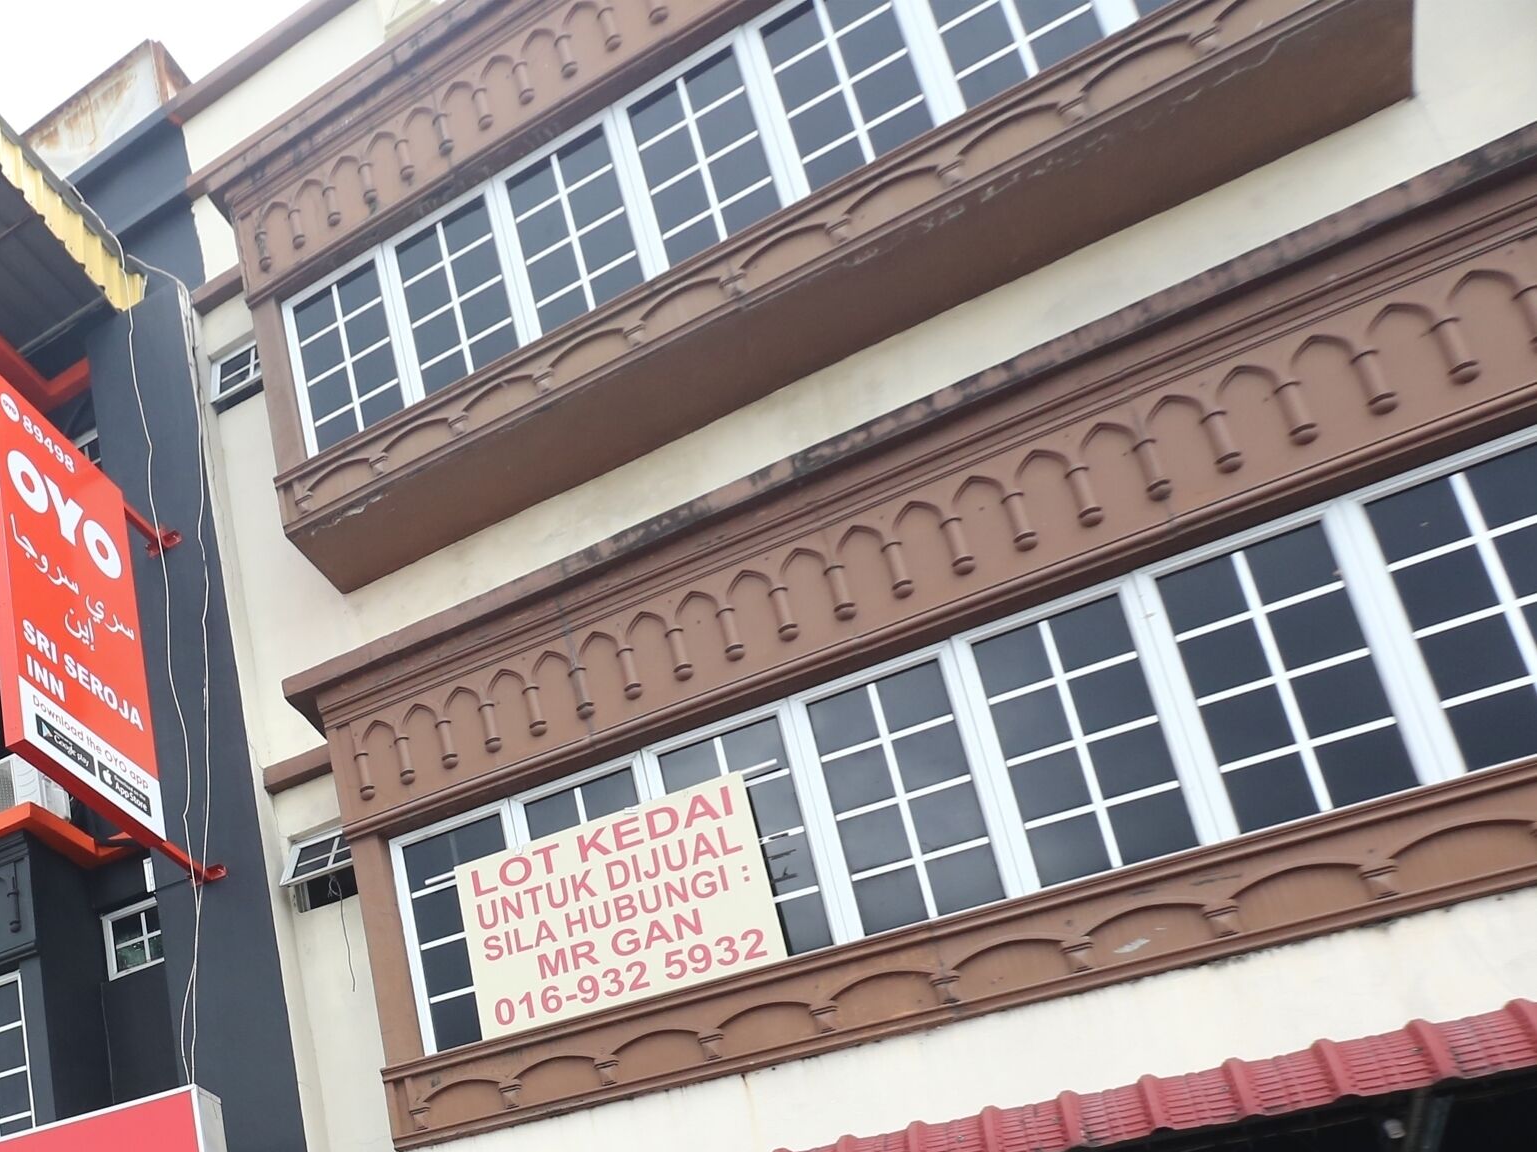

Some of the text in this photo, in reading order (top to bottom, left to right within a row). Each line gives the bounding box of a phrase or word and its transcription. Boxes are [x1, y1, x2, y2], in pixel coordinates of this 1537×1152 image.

[23, 414, 75, 474] 89498
[7, 450, 122, 579] OYO
[10, 514, 135, 640] سري سروجا
[23, 620, 144, 732] SRI SEROJA
[26, 654, 65, 702] INN
[33, 695, 84, 741] Download
[86, 736, 102, 754] the
[105, 750, 127, 773] OYO
[130, 769, 149, 789] app
[115, 782, 148, 812] App Store
[470, 785, 736, 898] LOT KEDAI
[476, 826, 744, 931] UNTUK DIJUAL
[483, 919, 558, 961] SILA
[564, 865, 729, 939] HUBUNGI
[494, 928, 769, 1027] 016-932 5932
[536, 908, 704, 981] MR GAN
